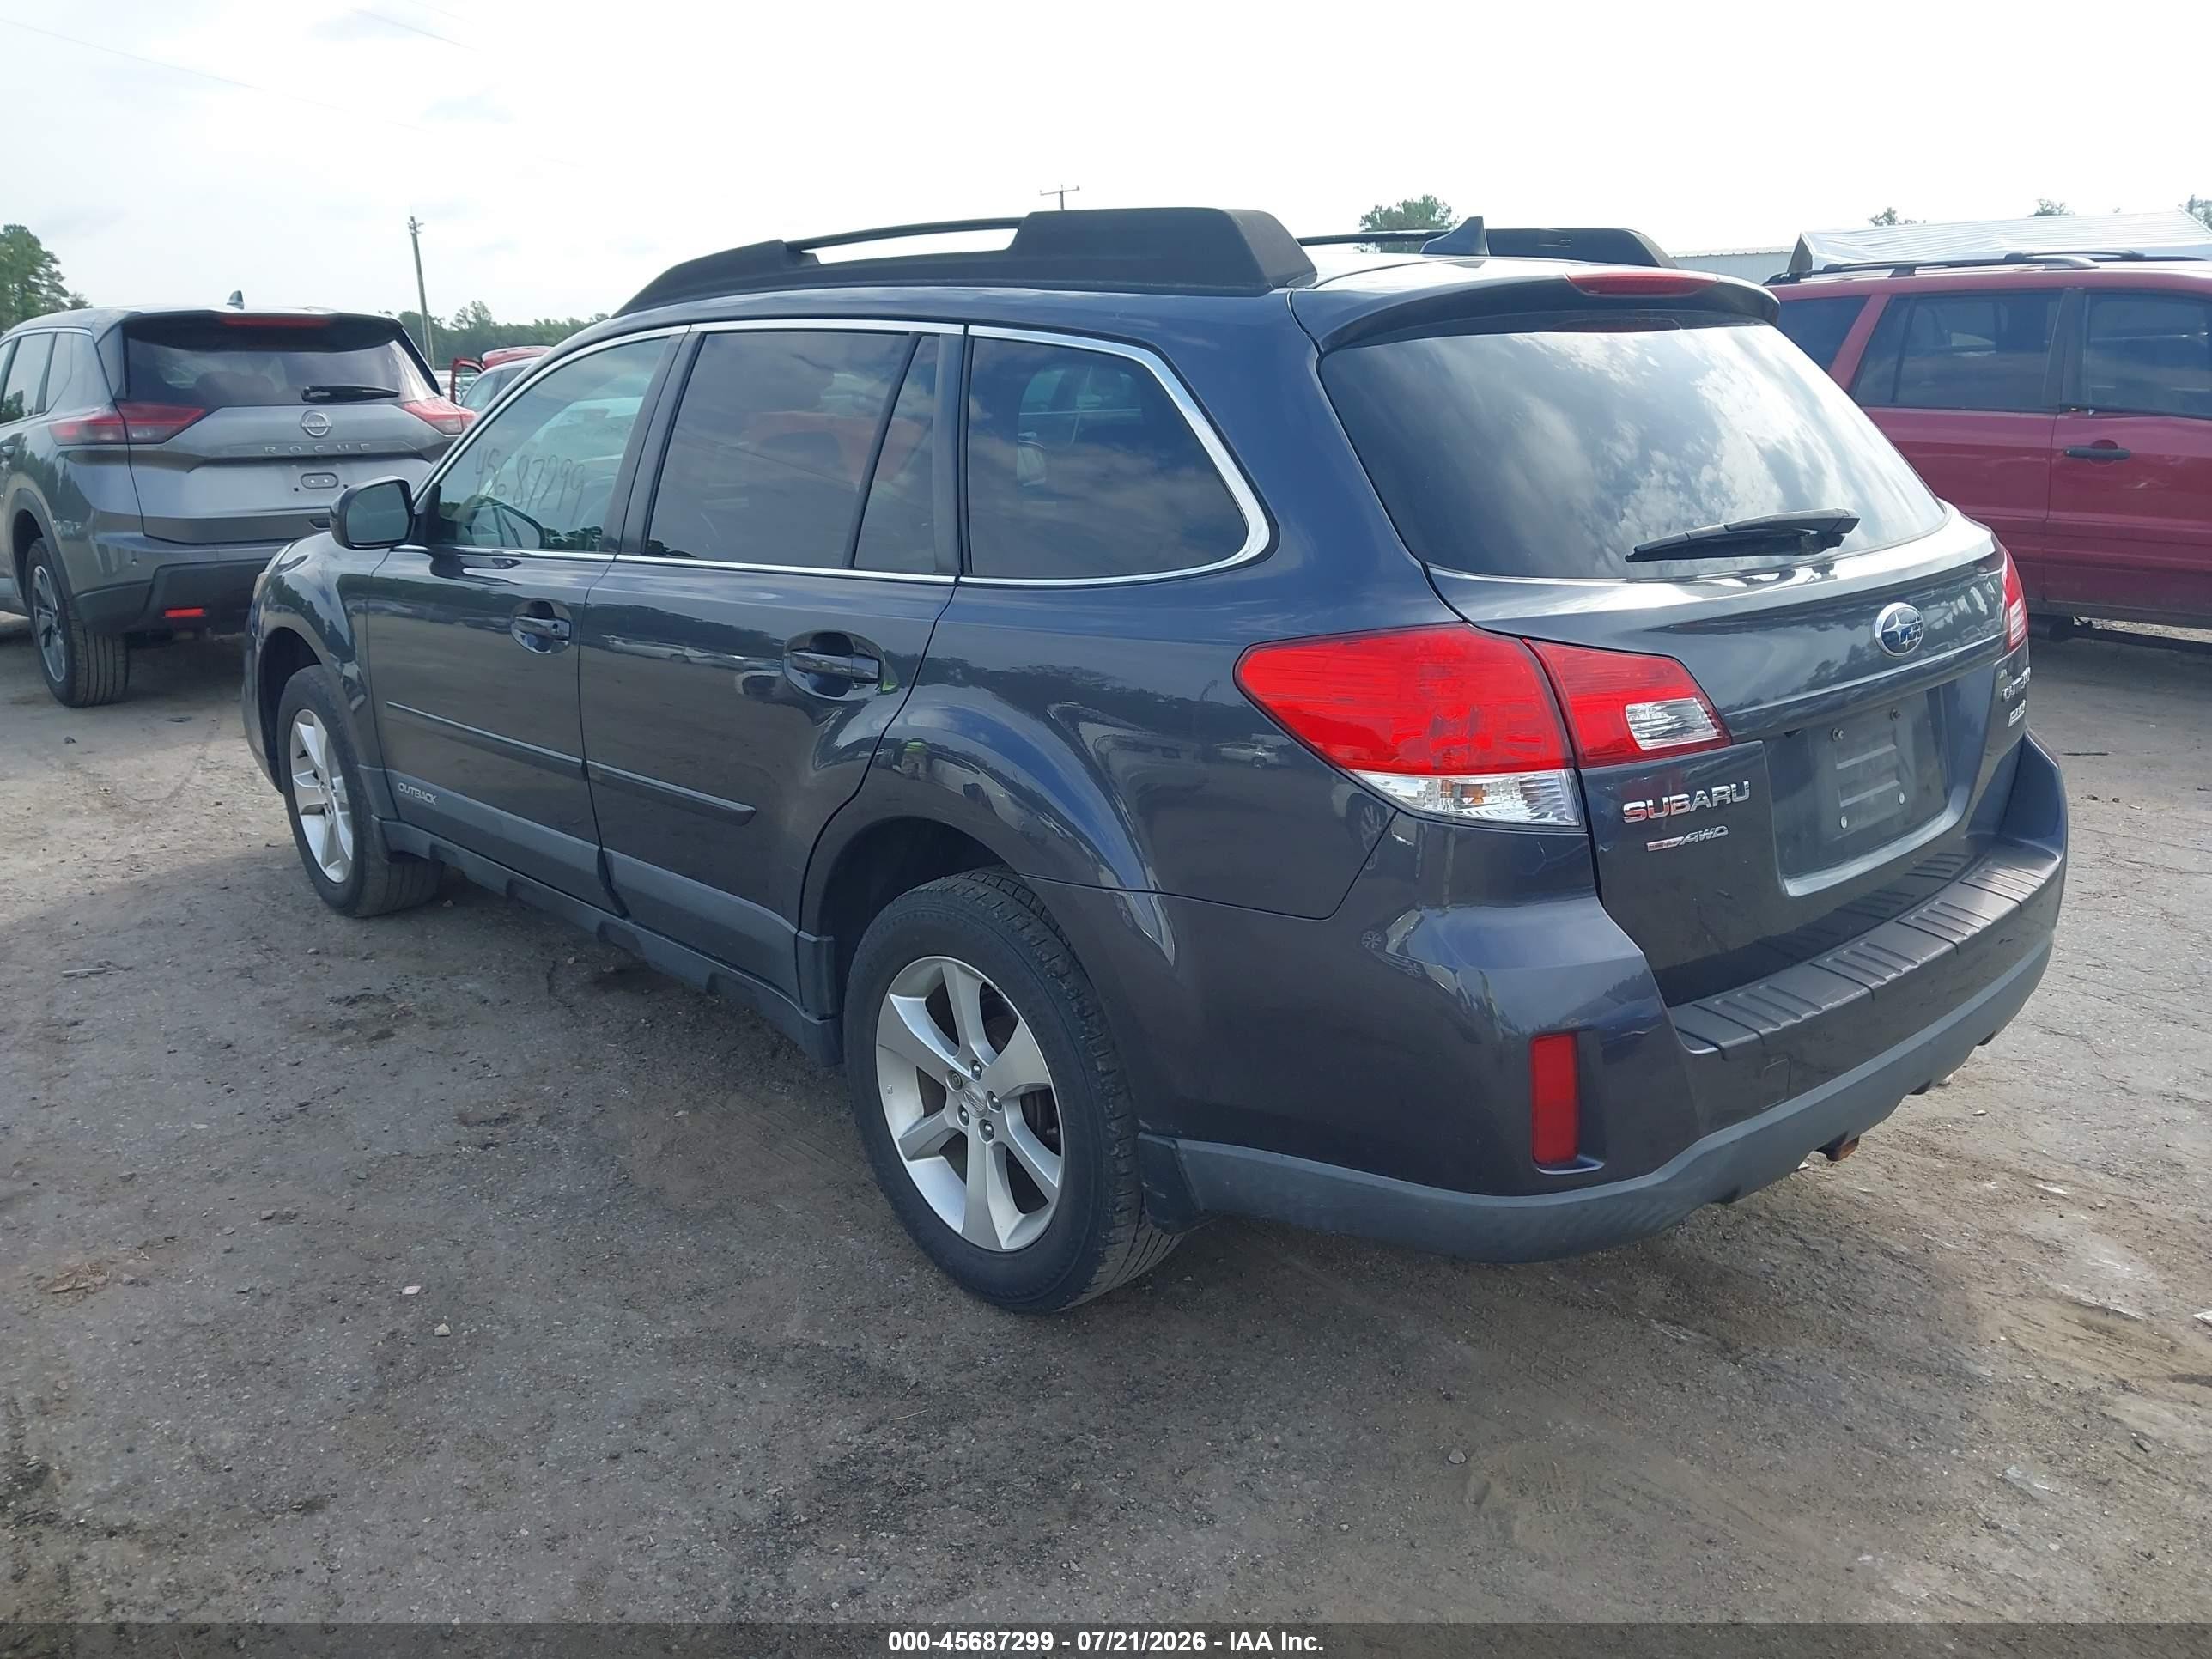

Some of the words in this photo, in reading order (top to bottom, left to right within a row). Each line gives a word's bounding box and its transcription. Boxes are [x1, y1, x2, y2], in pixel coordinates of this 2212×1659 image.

[264, 443, 371, 455] ROGUE
[474, 445, 586, 526] 45687299
[398, 782, 437, 805] OUTBACK
[1622, 780, 1751, 824] SUBARU
[1678, 824, 1729, 847] AWD
